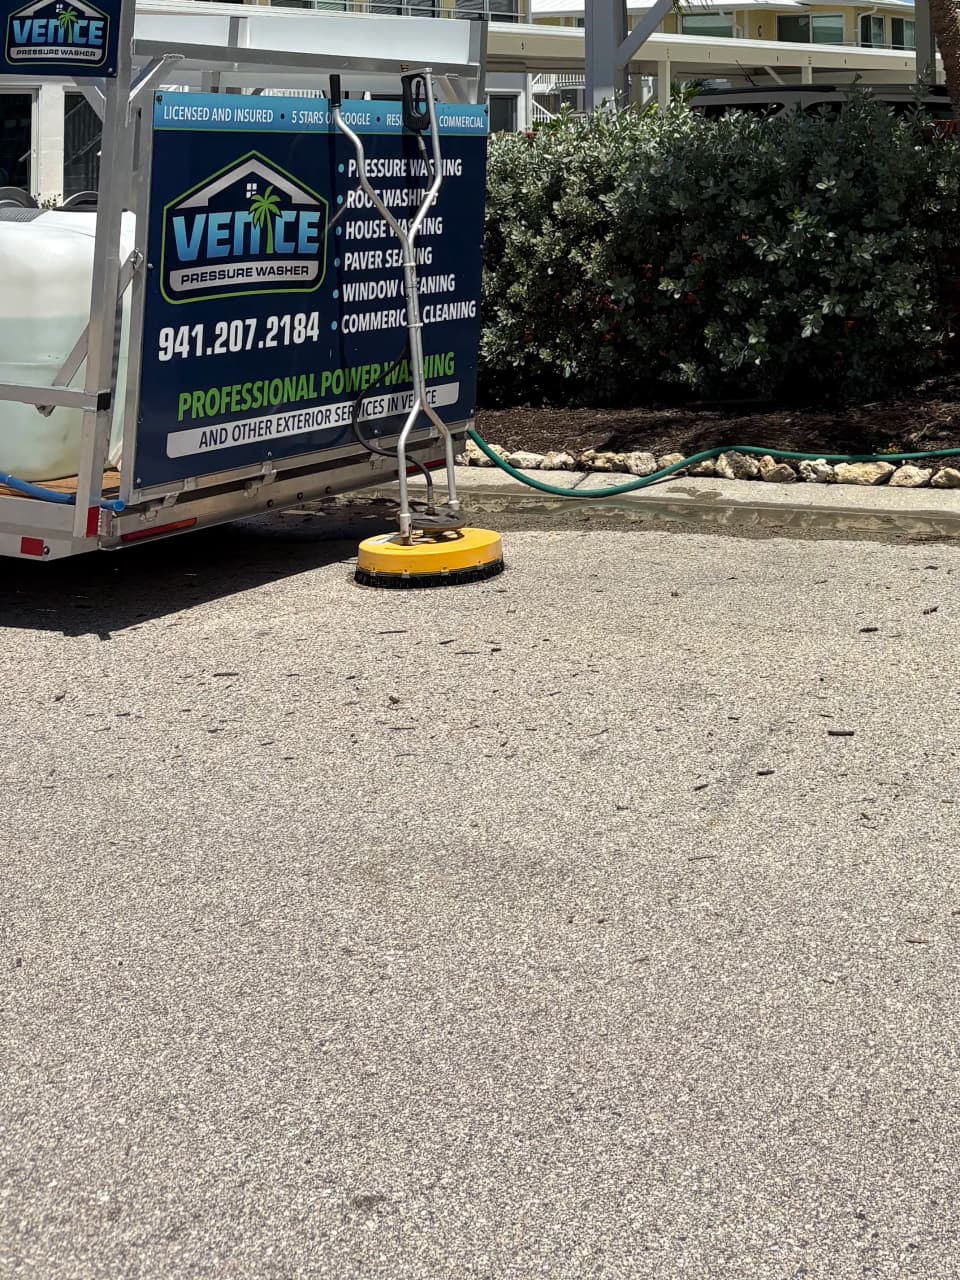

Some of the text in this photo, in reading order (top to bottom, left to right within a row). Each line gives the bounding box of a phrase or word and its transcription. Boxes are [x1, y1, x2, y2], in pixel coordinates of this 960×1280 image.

[60, 49, 96, 57] WASHER
[163, 105, 274, 123] LICENSED AND INSURED
[291, 111, 297, 124] 5
[299, 111, 323, 125] STARS
[439, 115, 484, 128] COMMERCIAL
[347, 158, 463, 178] PESSURE WASING
[345, 219, 387, 240] HOUSE
[343, 246, 433, 272] PAVER SEAING
[181, 264, 309, 286] PRESSURE WASHER
[342, 273, 456, 303] WINDOW CEANING
[341, 300, 477, 335] COMMERIC CLEANING
[158, 312, 320, 362] 941.207.2184
[177, 351, 455, 421] PROFESSIONAL POWER WAHING
[199, 389, 437, 449] AND OTHER EXTERIOR SERICES IN VECE
